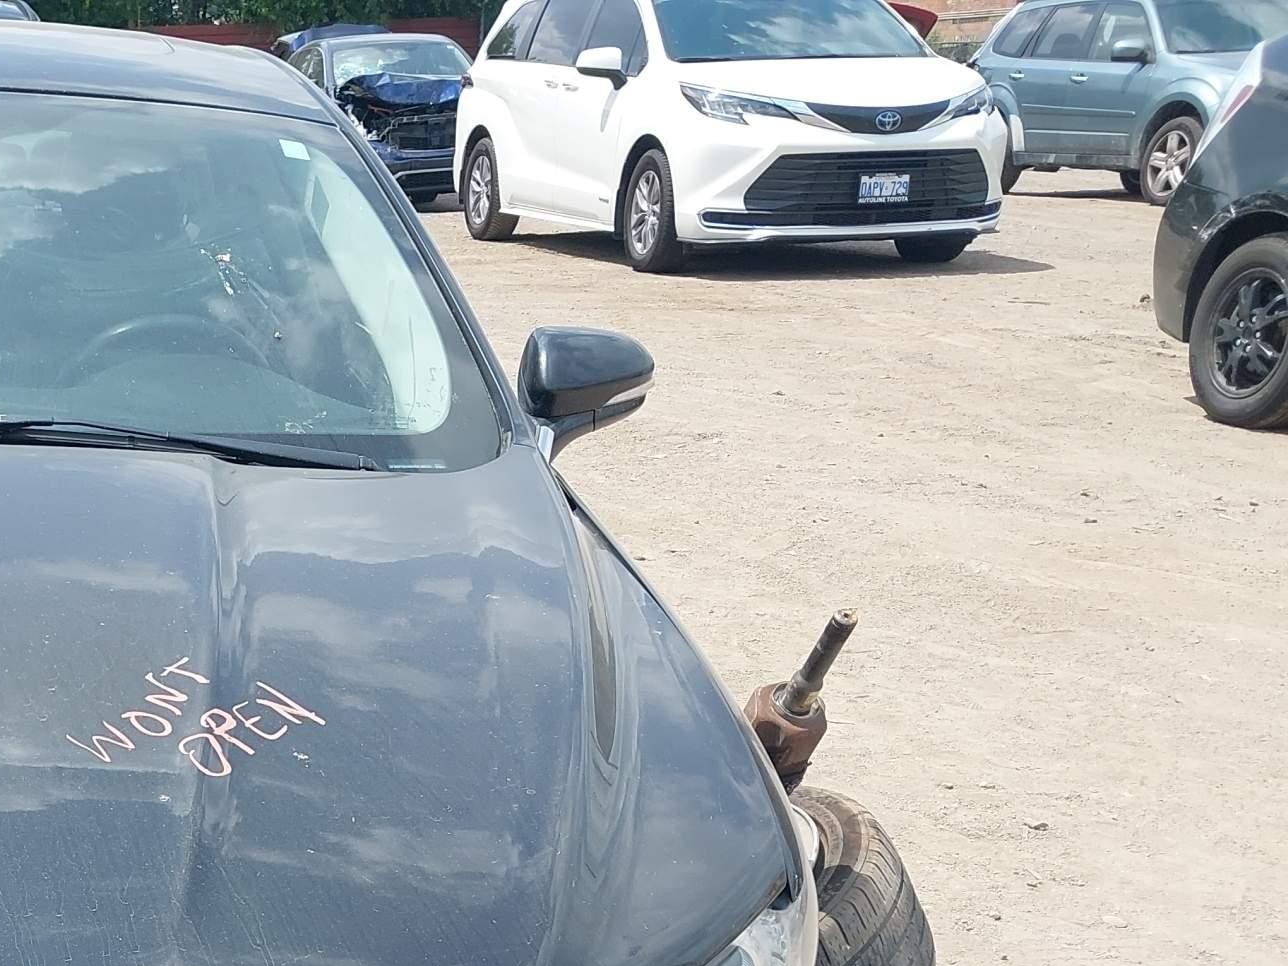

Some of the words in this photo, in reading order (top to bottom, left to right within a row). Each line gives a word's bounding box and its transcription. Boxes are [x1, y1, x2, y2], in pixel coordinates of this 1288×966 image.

[890, 180, 908, 196] 729
[65, 656, 210, 763] WONT
[178, 680, 326, 777] OPEN
